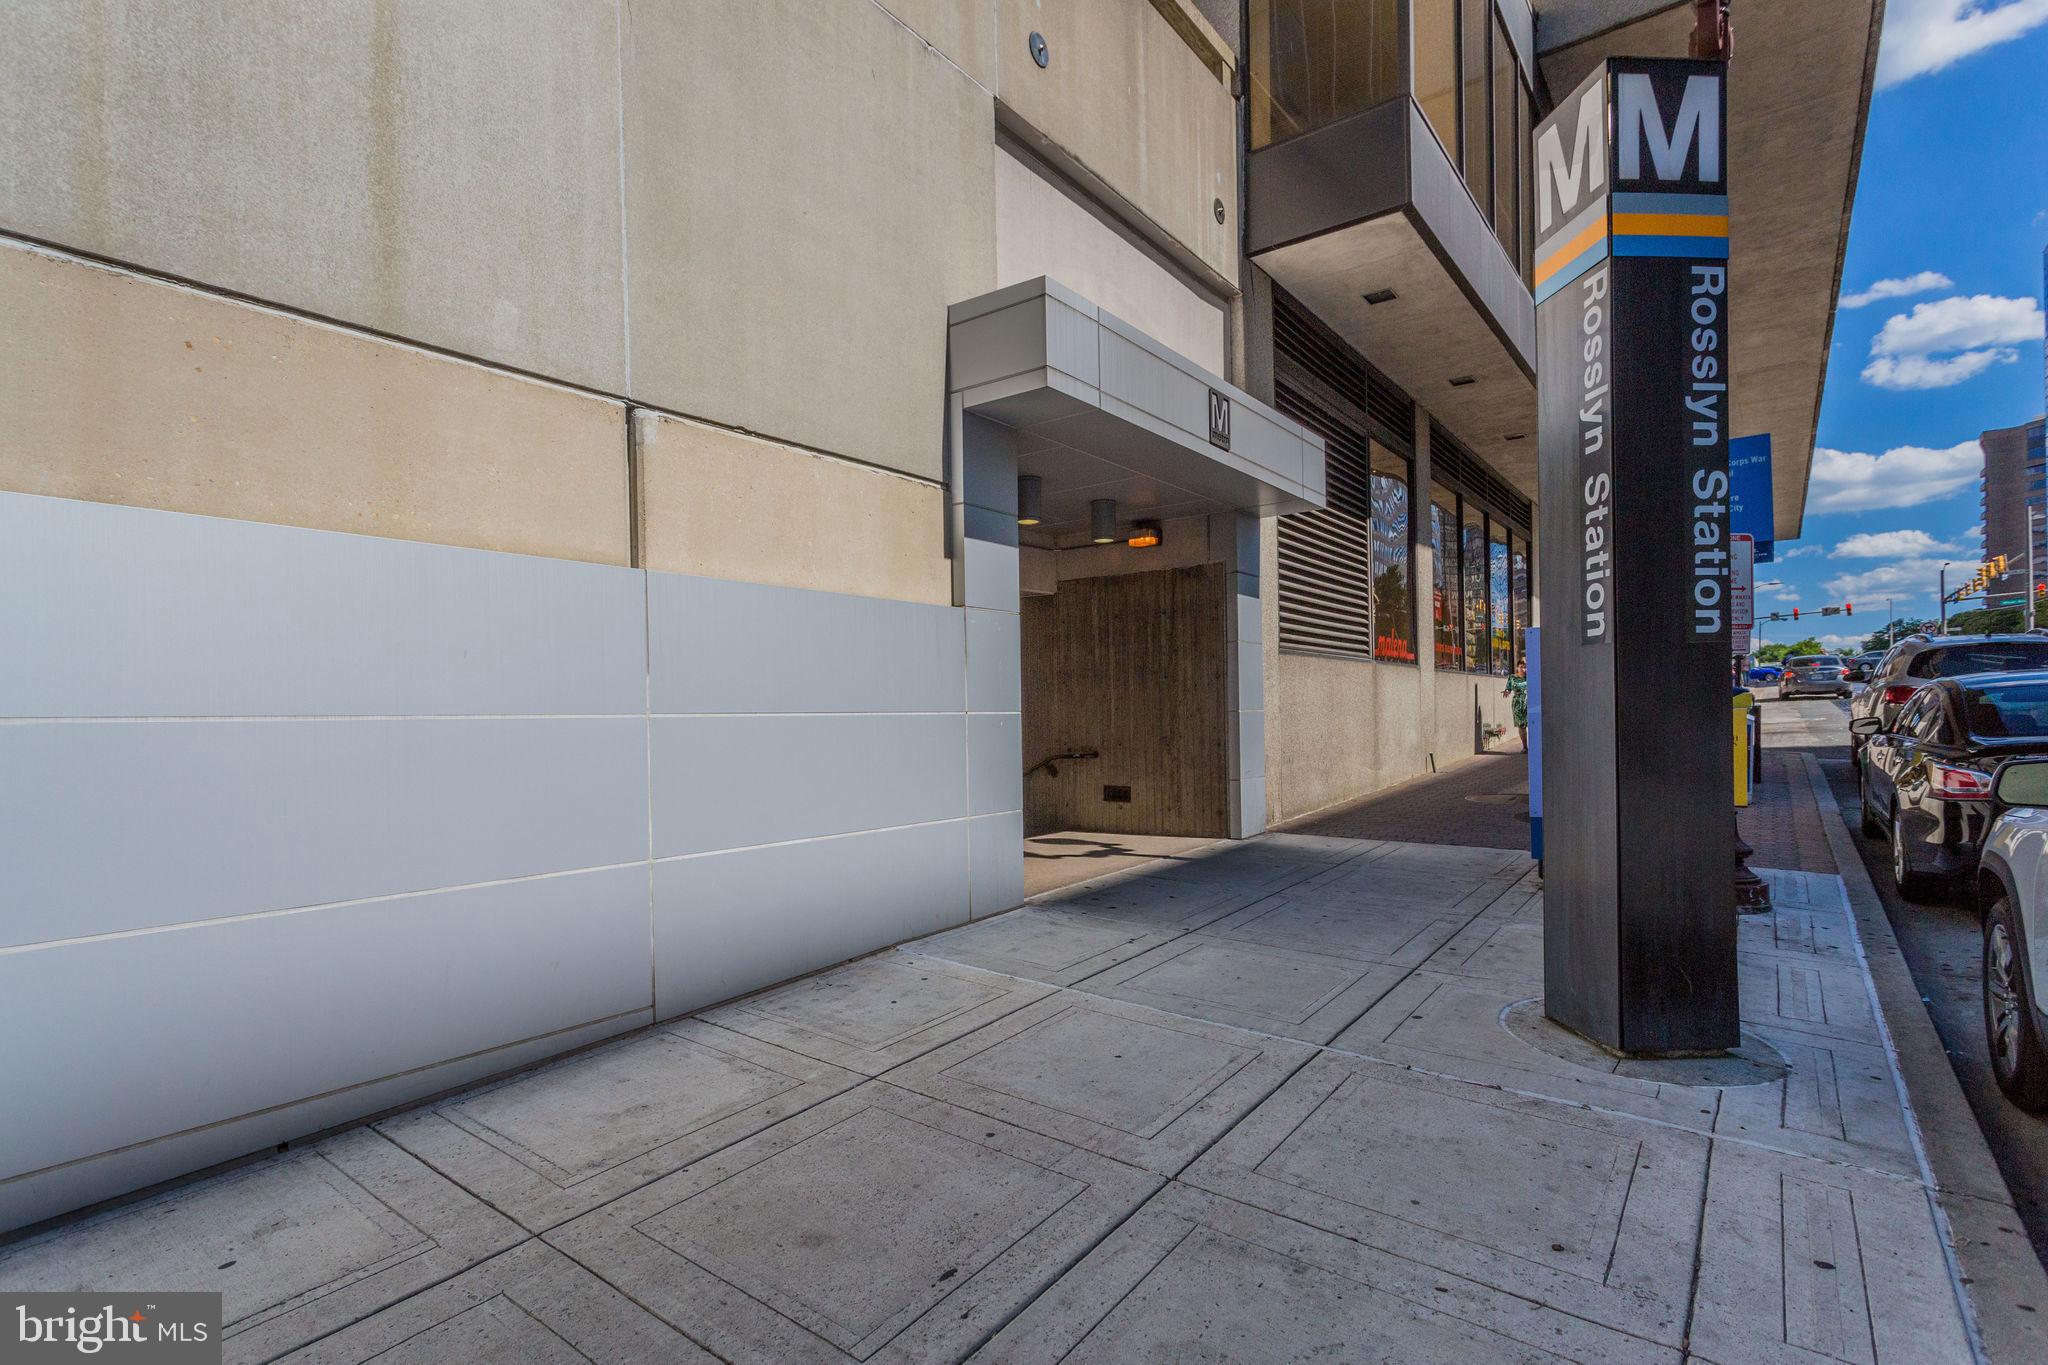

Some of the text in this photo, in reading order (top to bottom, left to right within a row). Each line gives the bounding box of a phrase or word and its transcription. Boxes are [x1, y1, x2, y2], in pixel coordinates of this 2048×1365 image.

[1538, 79, 1604, 233] M
[1618, 73, 1720, 182] M
[1211, 393, 1229, 435] M
[1580, 265, 1611, 637] Rosslyn Station
[1685, 265, 1729, 634] Rosslyn Station
